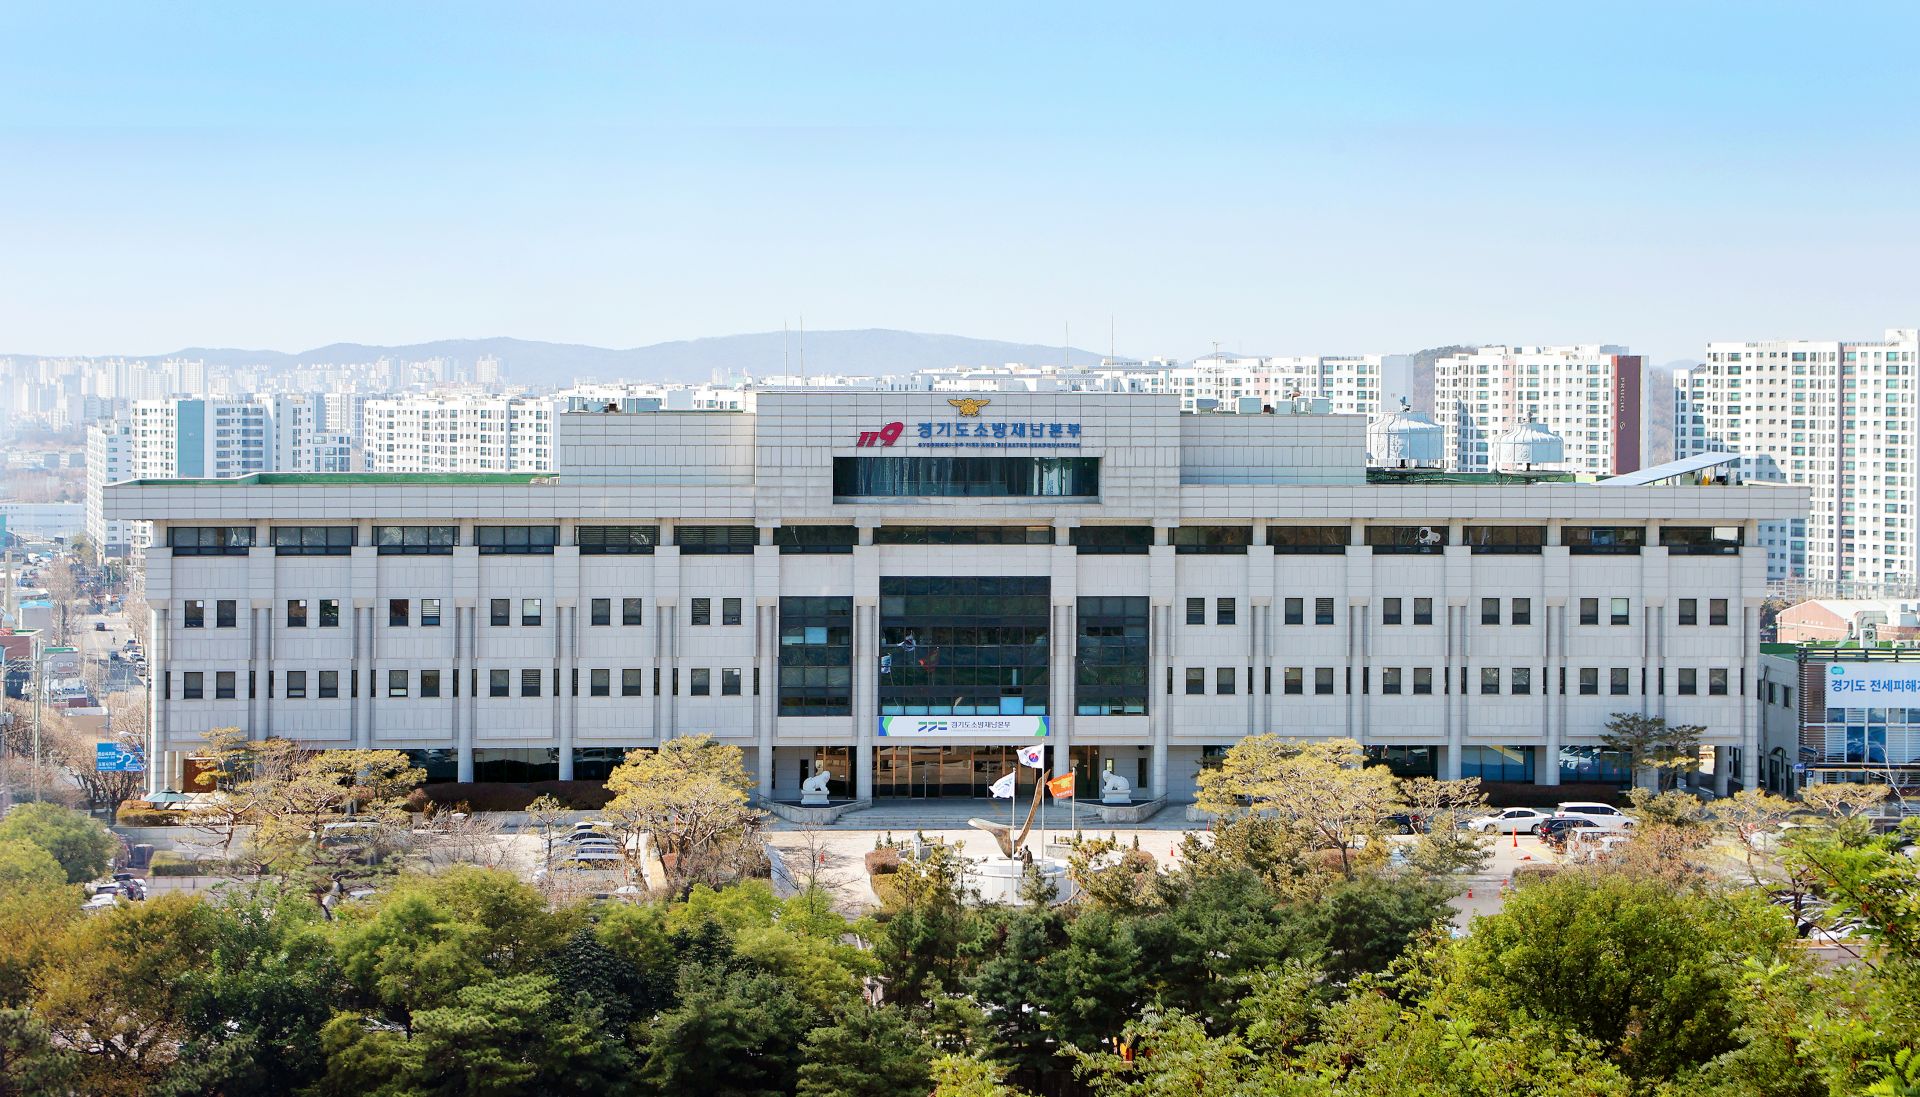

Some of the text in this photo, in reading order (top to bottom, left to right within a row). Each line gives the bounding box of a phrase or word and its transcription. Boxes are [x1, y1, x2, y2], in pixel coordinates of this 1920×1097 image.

[856, 421, 903, 447] 119
[918, 422, 1080, 438] 경기도소방재난본부
[1831, 680, 1866, 692] 경기도
